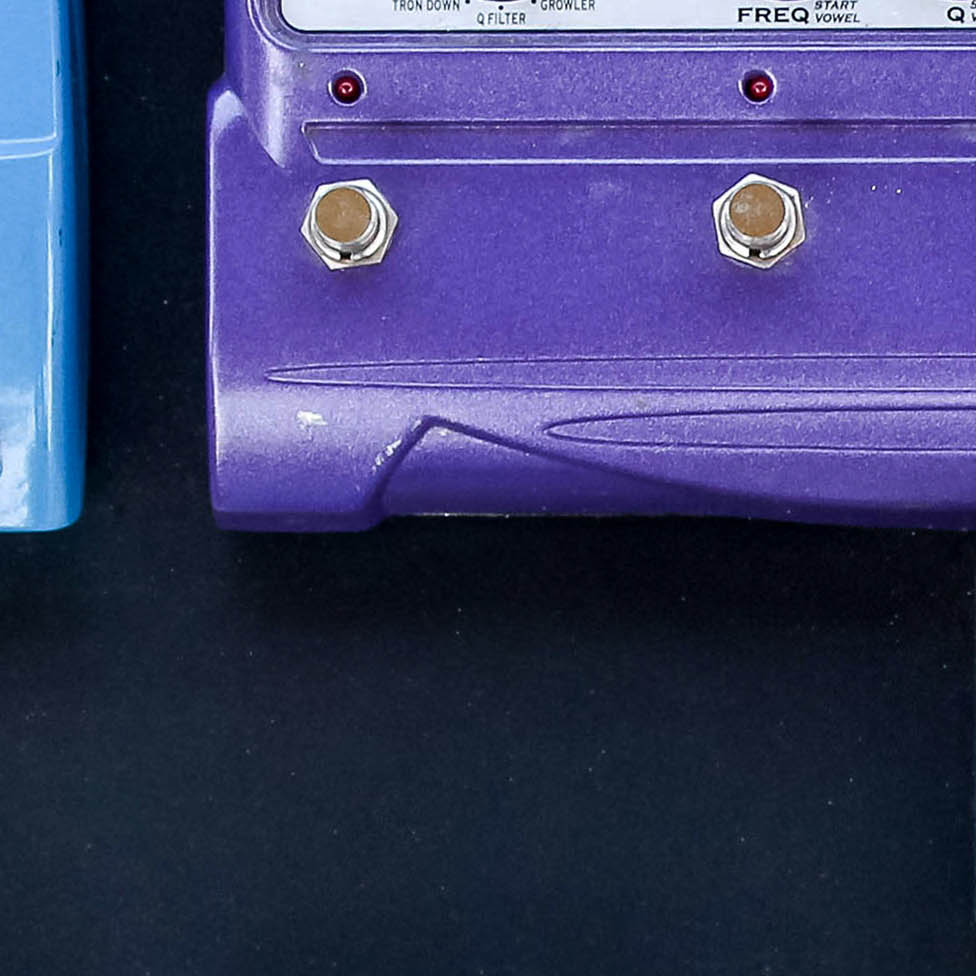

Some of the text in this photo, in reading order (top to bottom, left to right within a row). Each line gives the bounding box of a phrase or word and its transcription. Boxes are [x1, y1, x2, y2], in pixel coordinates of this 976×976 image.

[393, 0, 460, 11] TRON DOWN
[540, 0, 596, 10] GROWLER
[815, 0, 857, 10] START
[477, 12, 526, 25] Q FILTER
[737, 7, 810, 24] FREQ
[815, 13, 860, 23] VOWEL
[947, 6, 965, 24] Q
